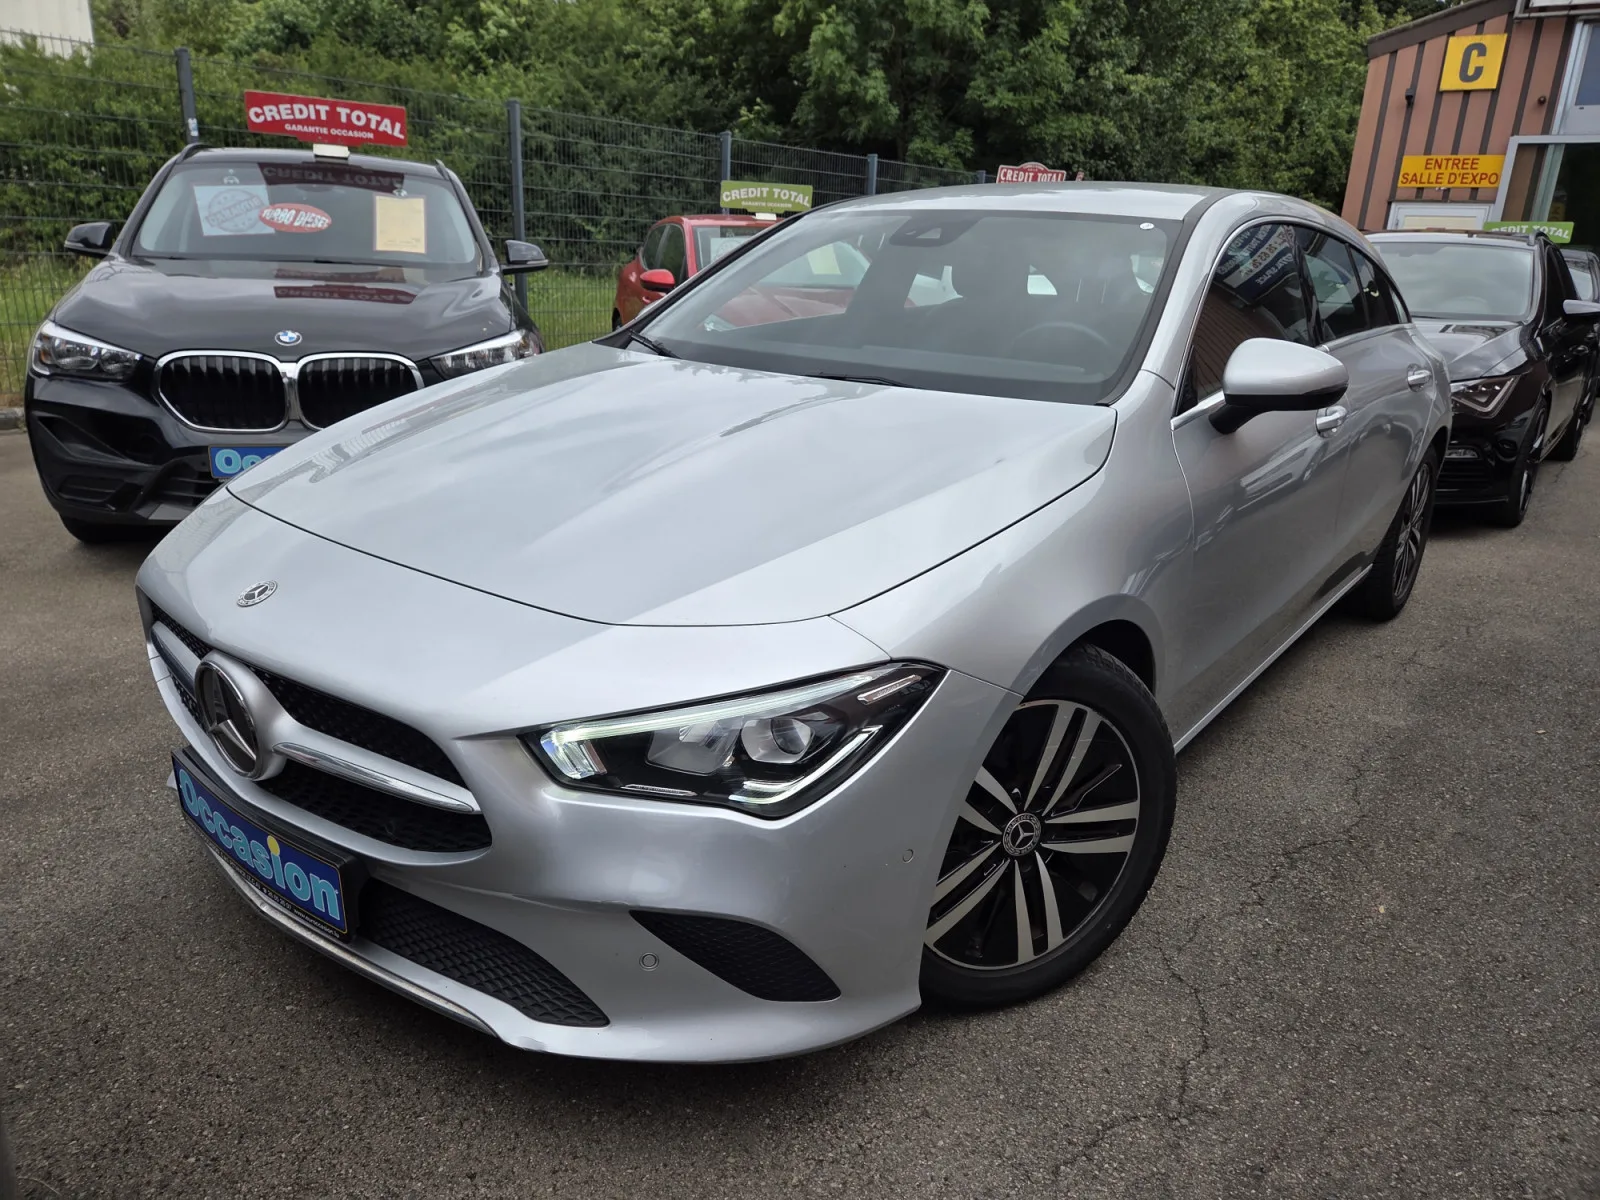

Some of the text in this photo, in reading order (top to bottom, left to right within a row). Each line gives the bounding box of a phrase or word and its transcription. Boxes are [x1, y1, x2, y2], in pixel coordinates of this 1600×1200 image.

[1458, 42, 1487, 83] C
[248, 103, 405, 140] CREDIT TOTAL
[284, 123, 375, 140] GARANTIE OCCASION
[1424, 157, 1480, 171] ENTREE
[1000, 168, 1034, 183] CREDIT
[1400, 172, 1500, 185] SALLE D'EXPO
[722, 187, 810, 208] CREDIT TOTAL
[263, 207, 330, 230] TURBO DIESEL
[178, 768, 341, 921] Occasion
